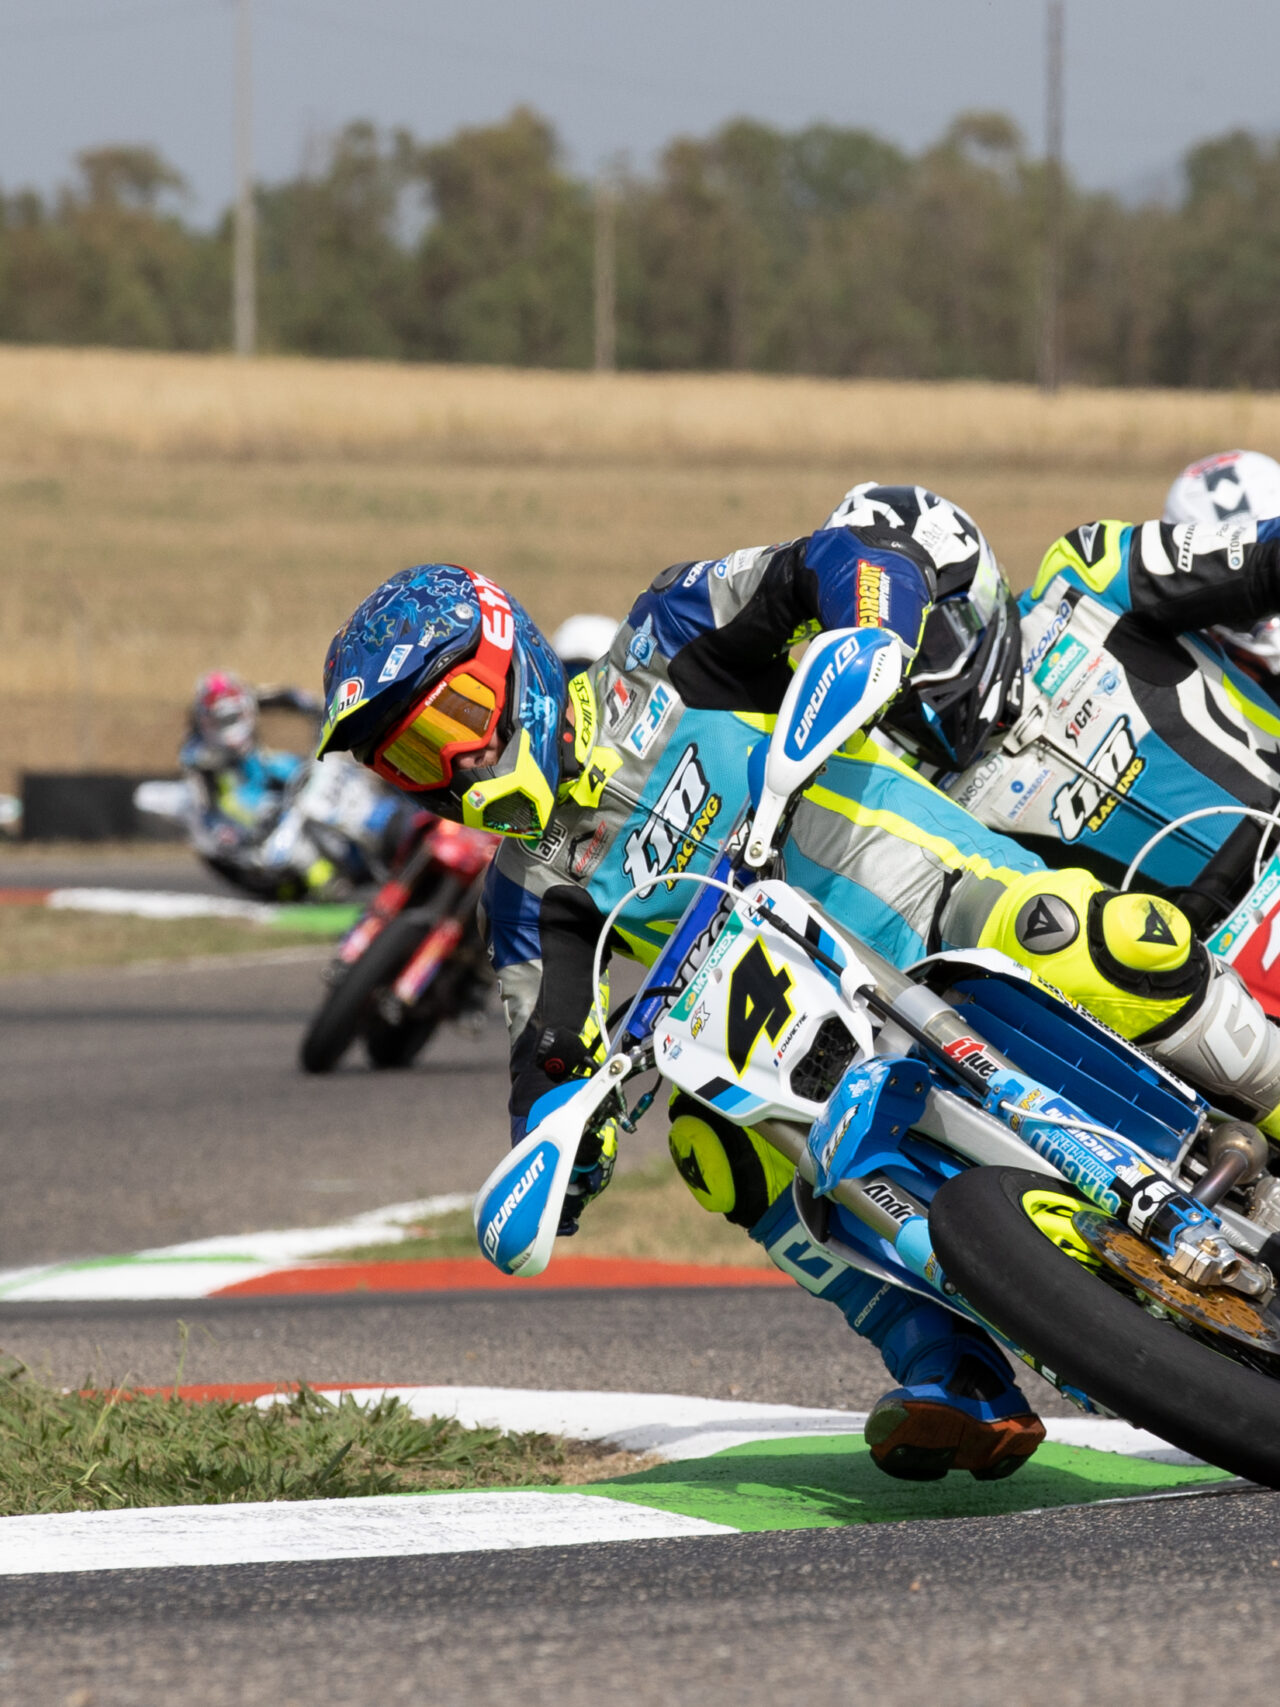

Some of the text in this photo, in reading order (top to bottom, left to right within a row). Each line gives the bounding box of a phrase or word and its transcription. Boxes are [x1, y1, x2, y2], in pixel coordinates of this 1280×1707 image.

[858, 562, 883, 628] CIRCUIT
[1041, 640, 1081, 692] MOTOREX
[573, 678, 594, 749] DAINESE
[793, 661, 837, 752] CIRCUIT
[1064, 697, 1094, 749] S1GP
[588, 764, 608, 793] 4
[1008, 768, 1051, 820] INTERMEDIA
[1087, 759, 1143, 832] RACING
[538, 825, 562, 856] agv
[694, 930, 737, 994] MOTOREX
[727, 937, 794, 1077] 4
[493, 1151, 546, 1235] CIRCUIT
[1029, 1128, 1121, 1217] CIRCUIT
[1049, 1130, 1115, 1191] EQUIPMENT
